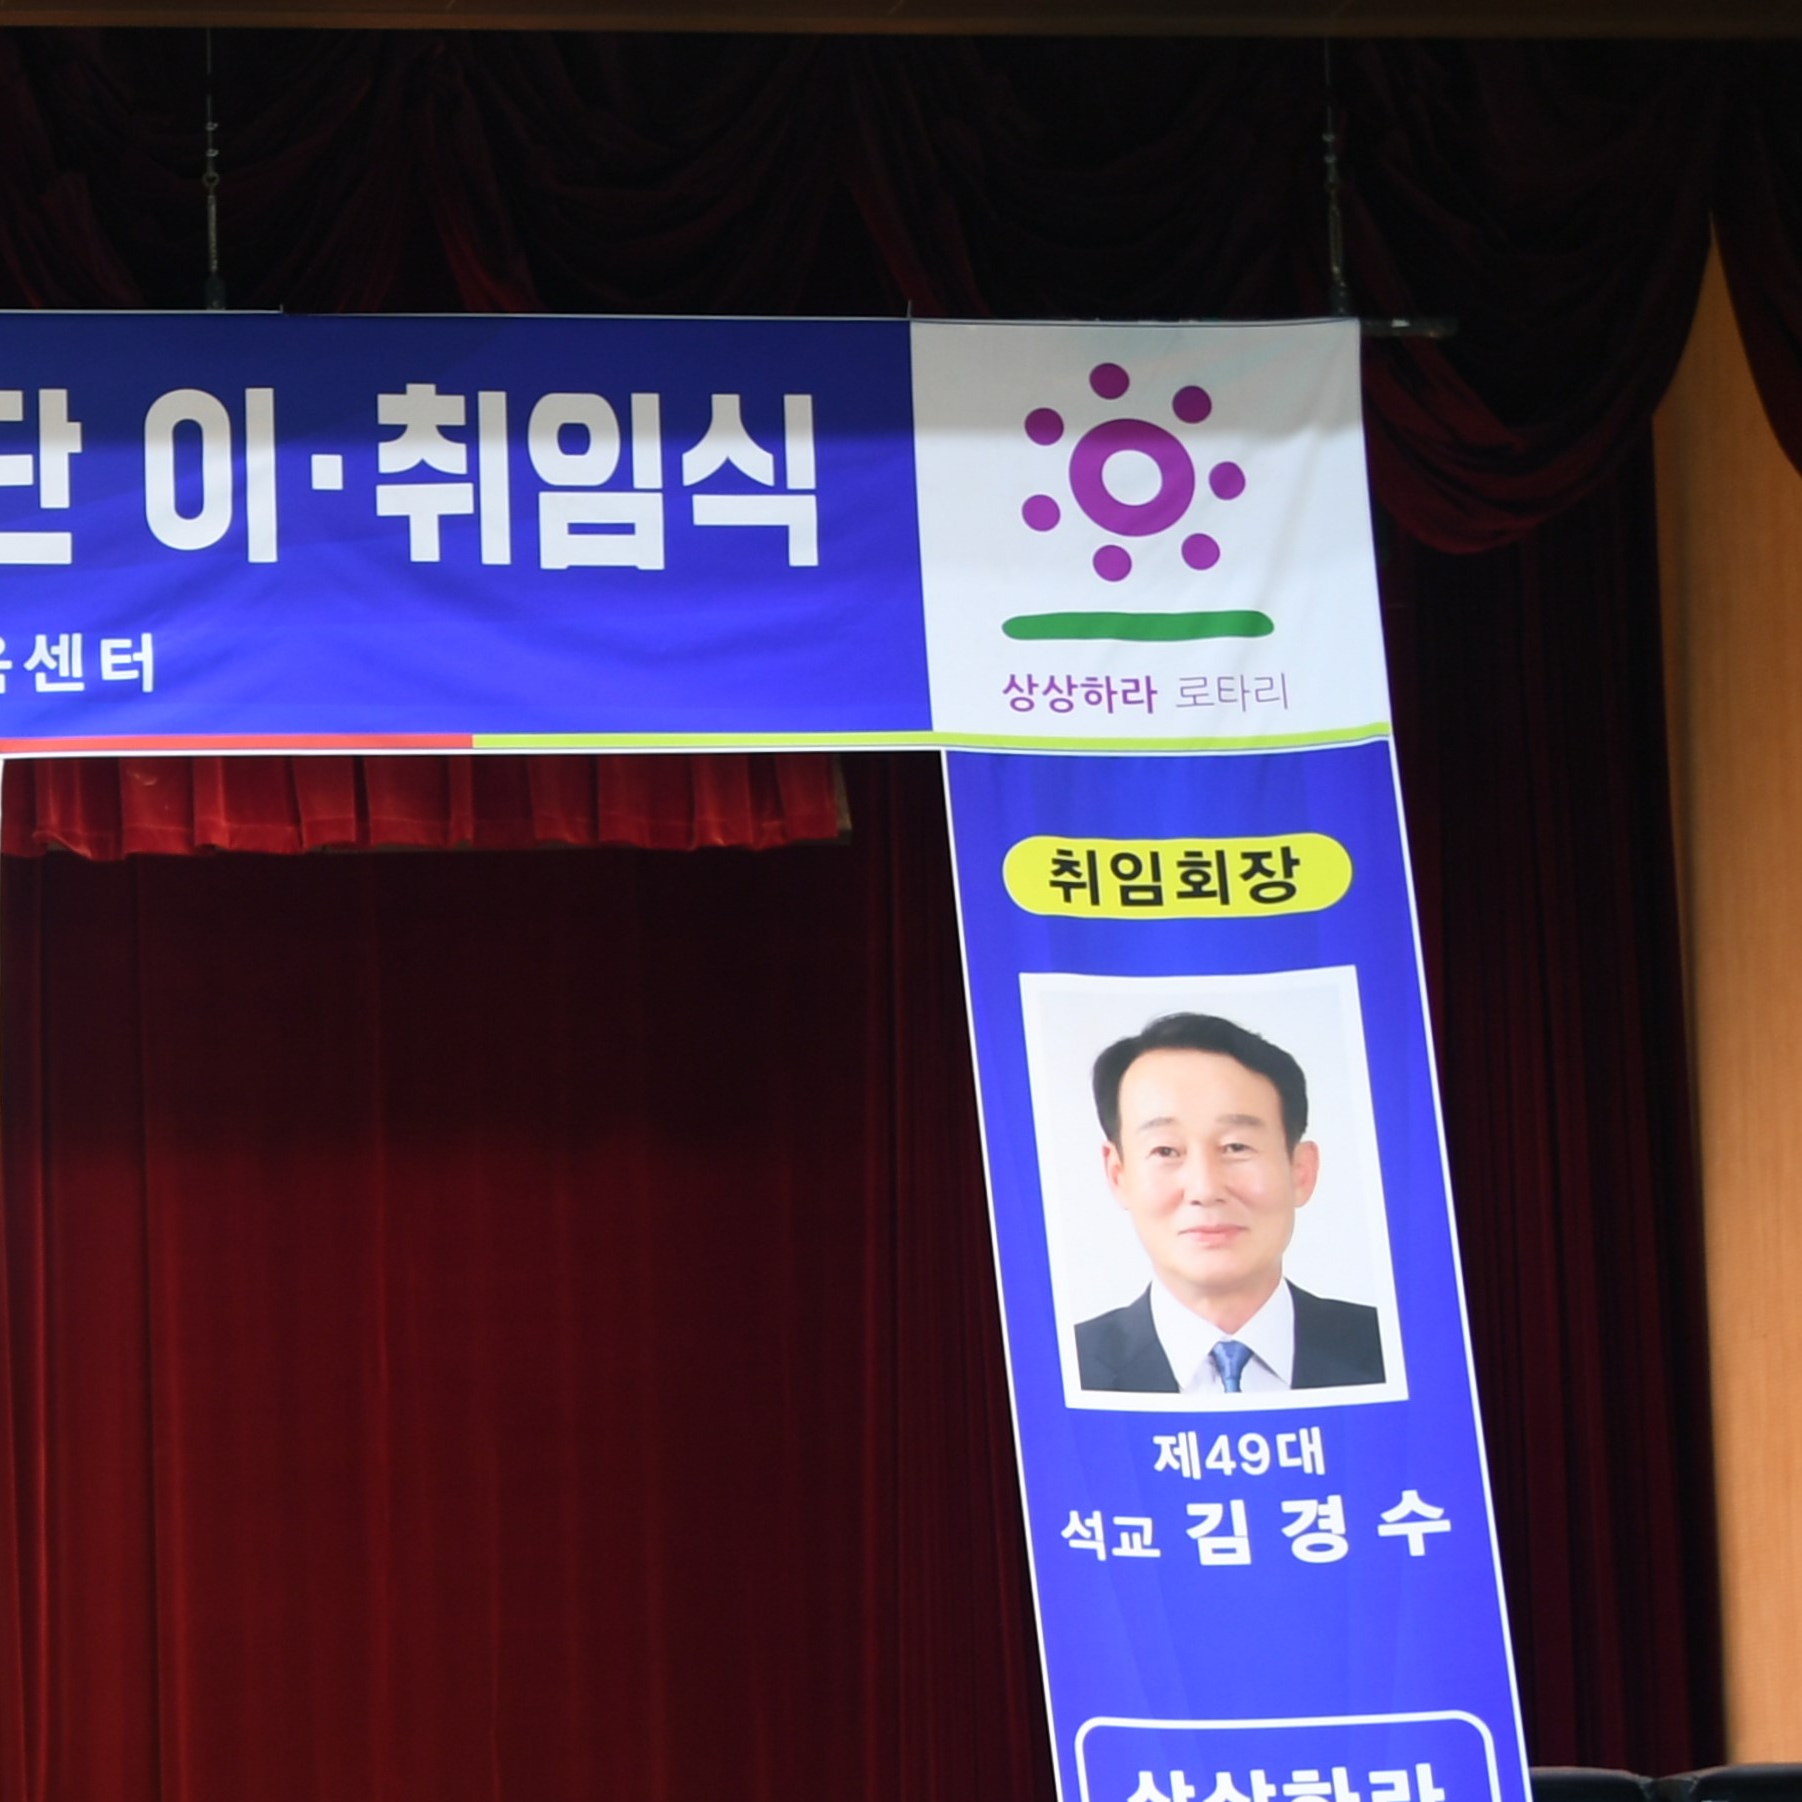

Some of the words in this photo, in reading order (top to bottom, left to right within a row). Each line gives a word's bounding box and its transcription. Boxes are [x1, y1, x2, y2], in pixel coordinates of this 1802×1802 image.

[1001, 673, 1159, 714] 상상하라
[1174, 672, 1289, 712] 로타리
[1048, 846, 1301, 907] 취임회장
[1152, 1427, 1327, 1480] 제49대
[1060, 1507, 1162, 1562] 석교
